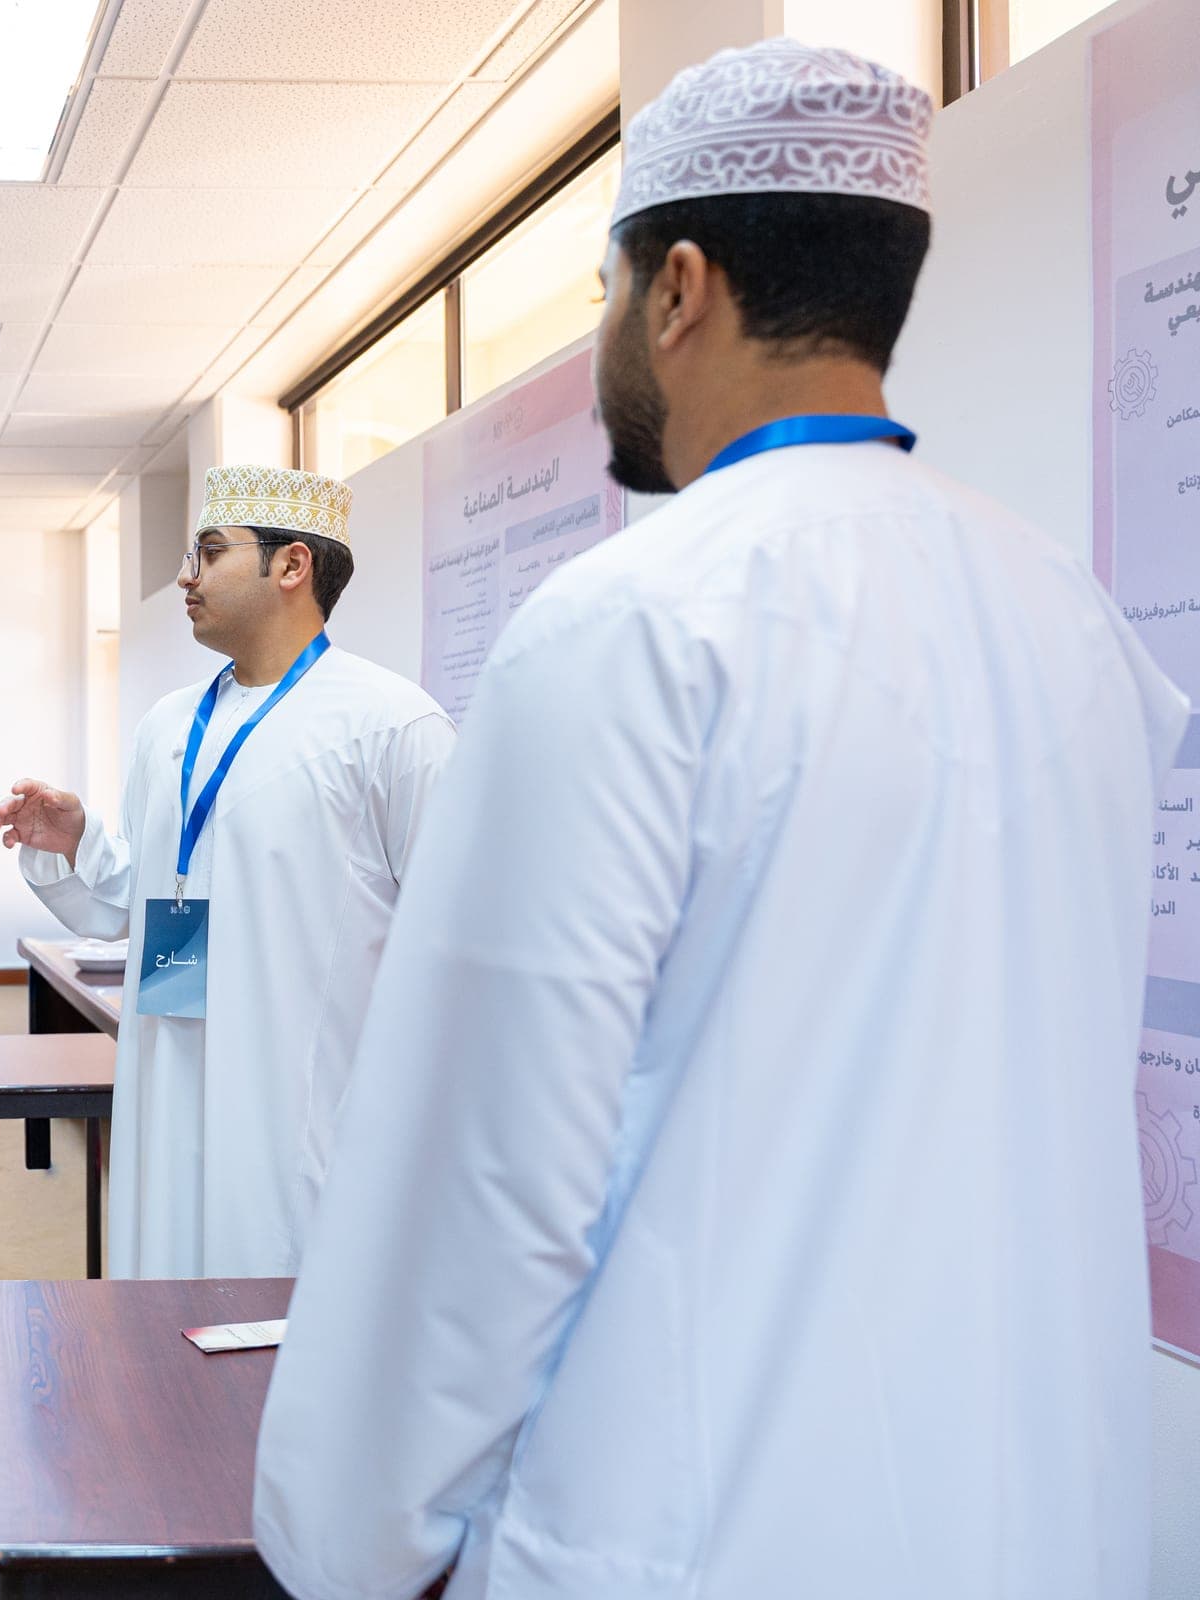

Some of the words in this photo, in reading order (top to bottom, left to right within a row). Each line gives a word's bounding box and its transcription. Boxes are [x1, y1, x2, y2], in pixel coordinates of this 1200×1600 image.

[507, 457, 560, 500] الهندسة
[464, 481, 504, 525] الصناعية
[1152, 862, 1179, 881] الأكا
[155, 951, 198, 968] شارح
